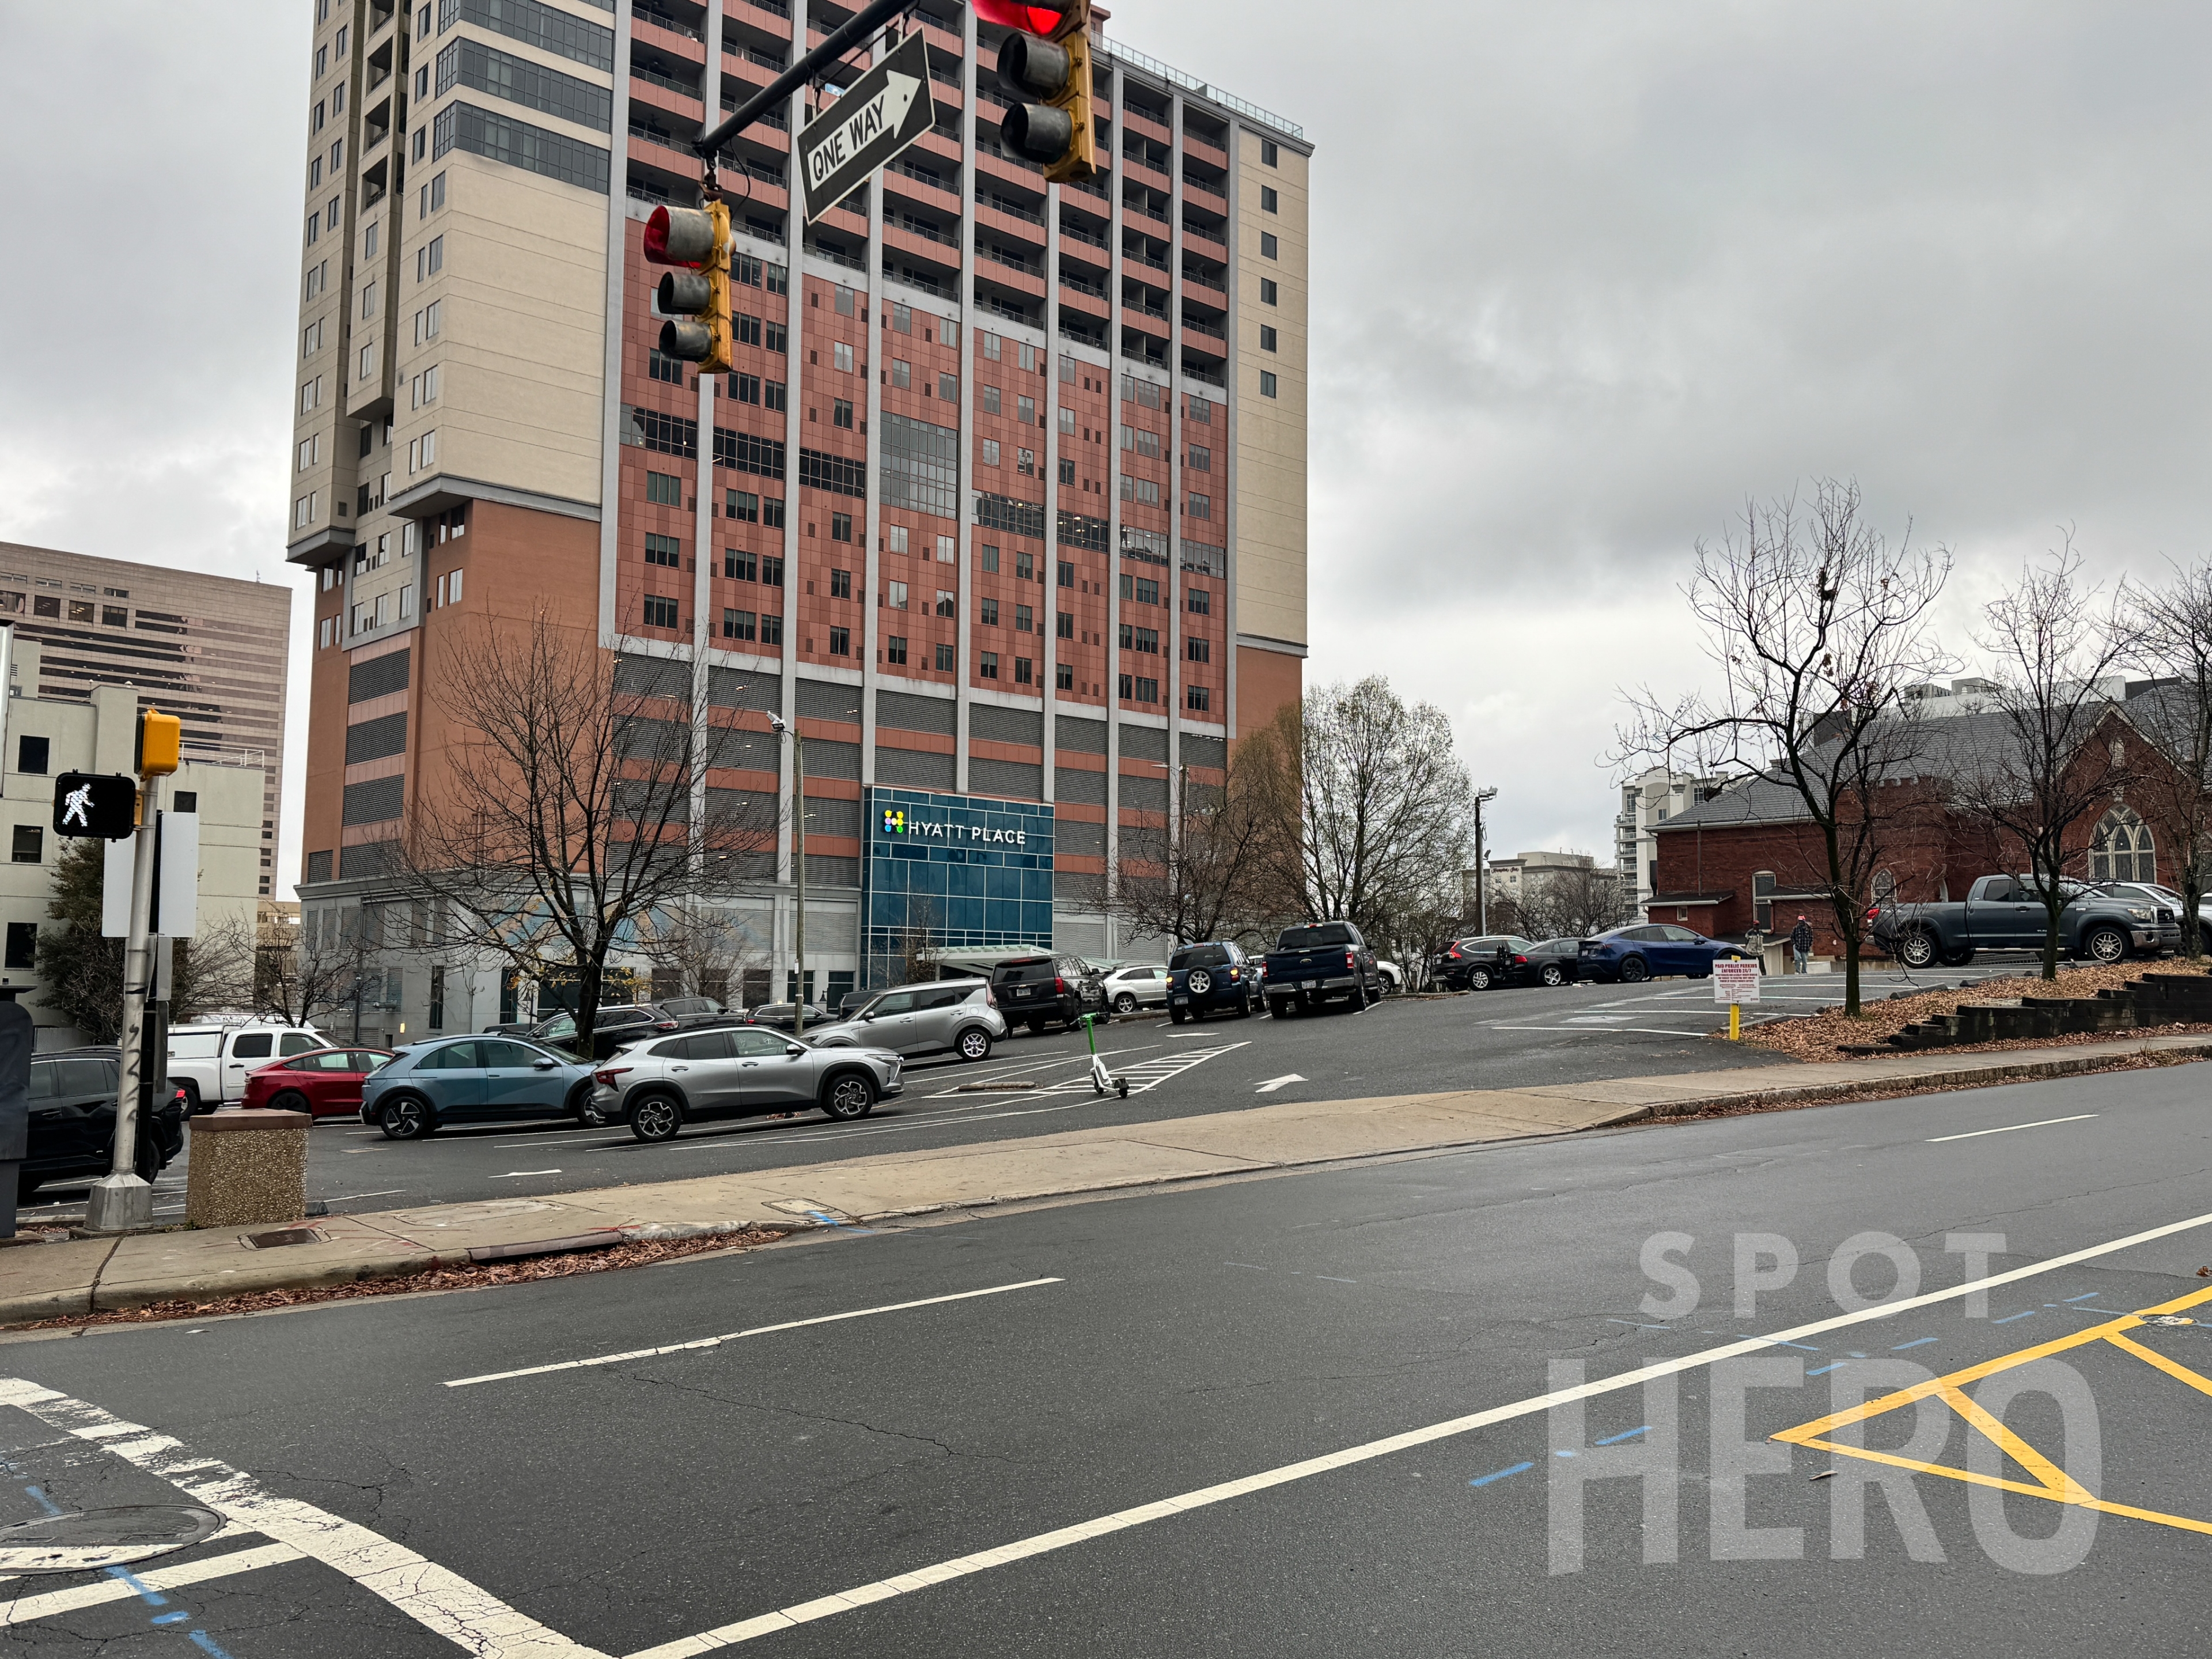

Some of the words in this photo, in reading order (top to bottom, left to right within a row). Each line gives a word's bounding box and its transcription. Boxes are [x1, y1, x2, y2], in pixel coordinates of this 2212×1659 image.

[813, 130, 846, 181] ONE
[849, 94, 884, 151] WAY
[908, 820, 964, 839] HYATT
[972, 826, 1025, 844] PLACE
